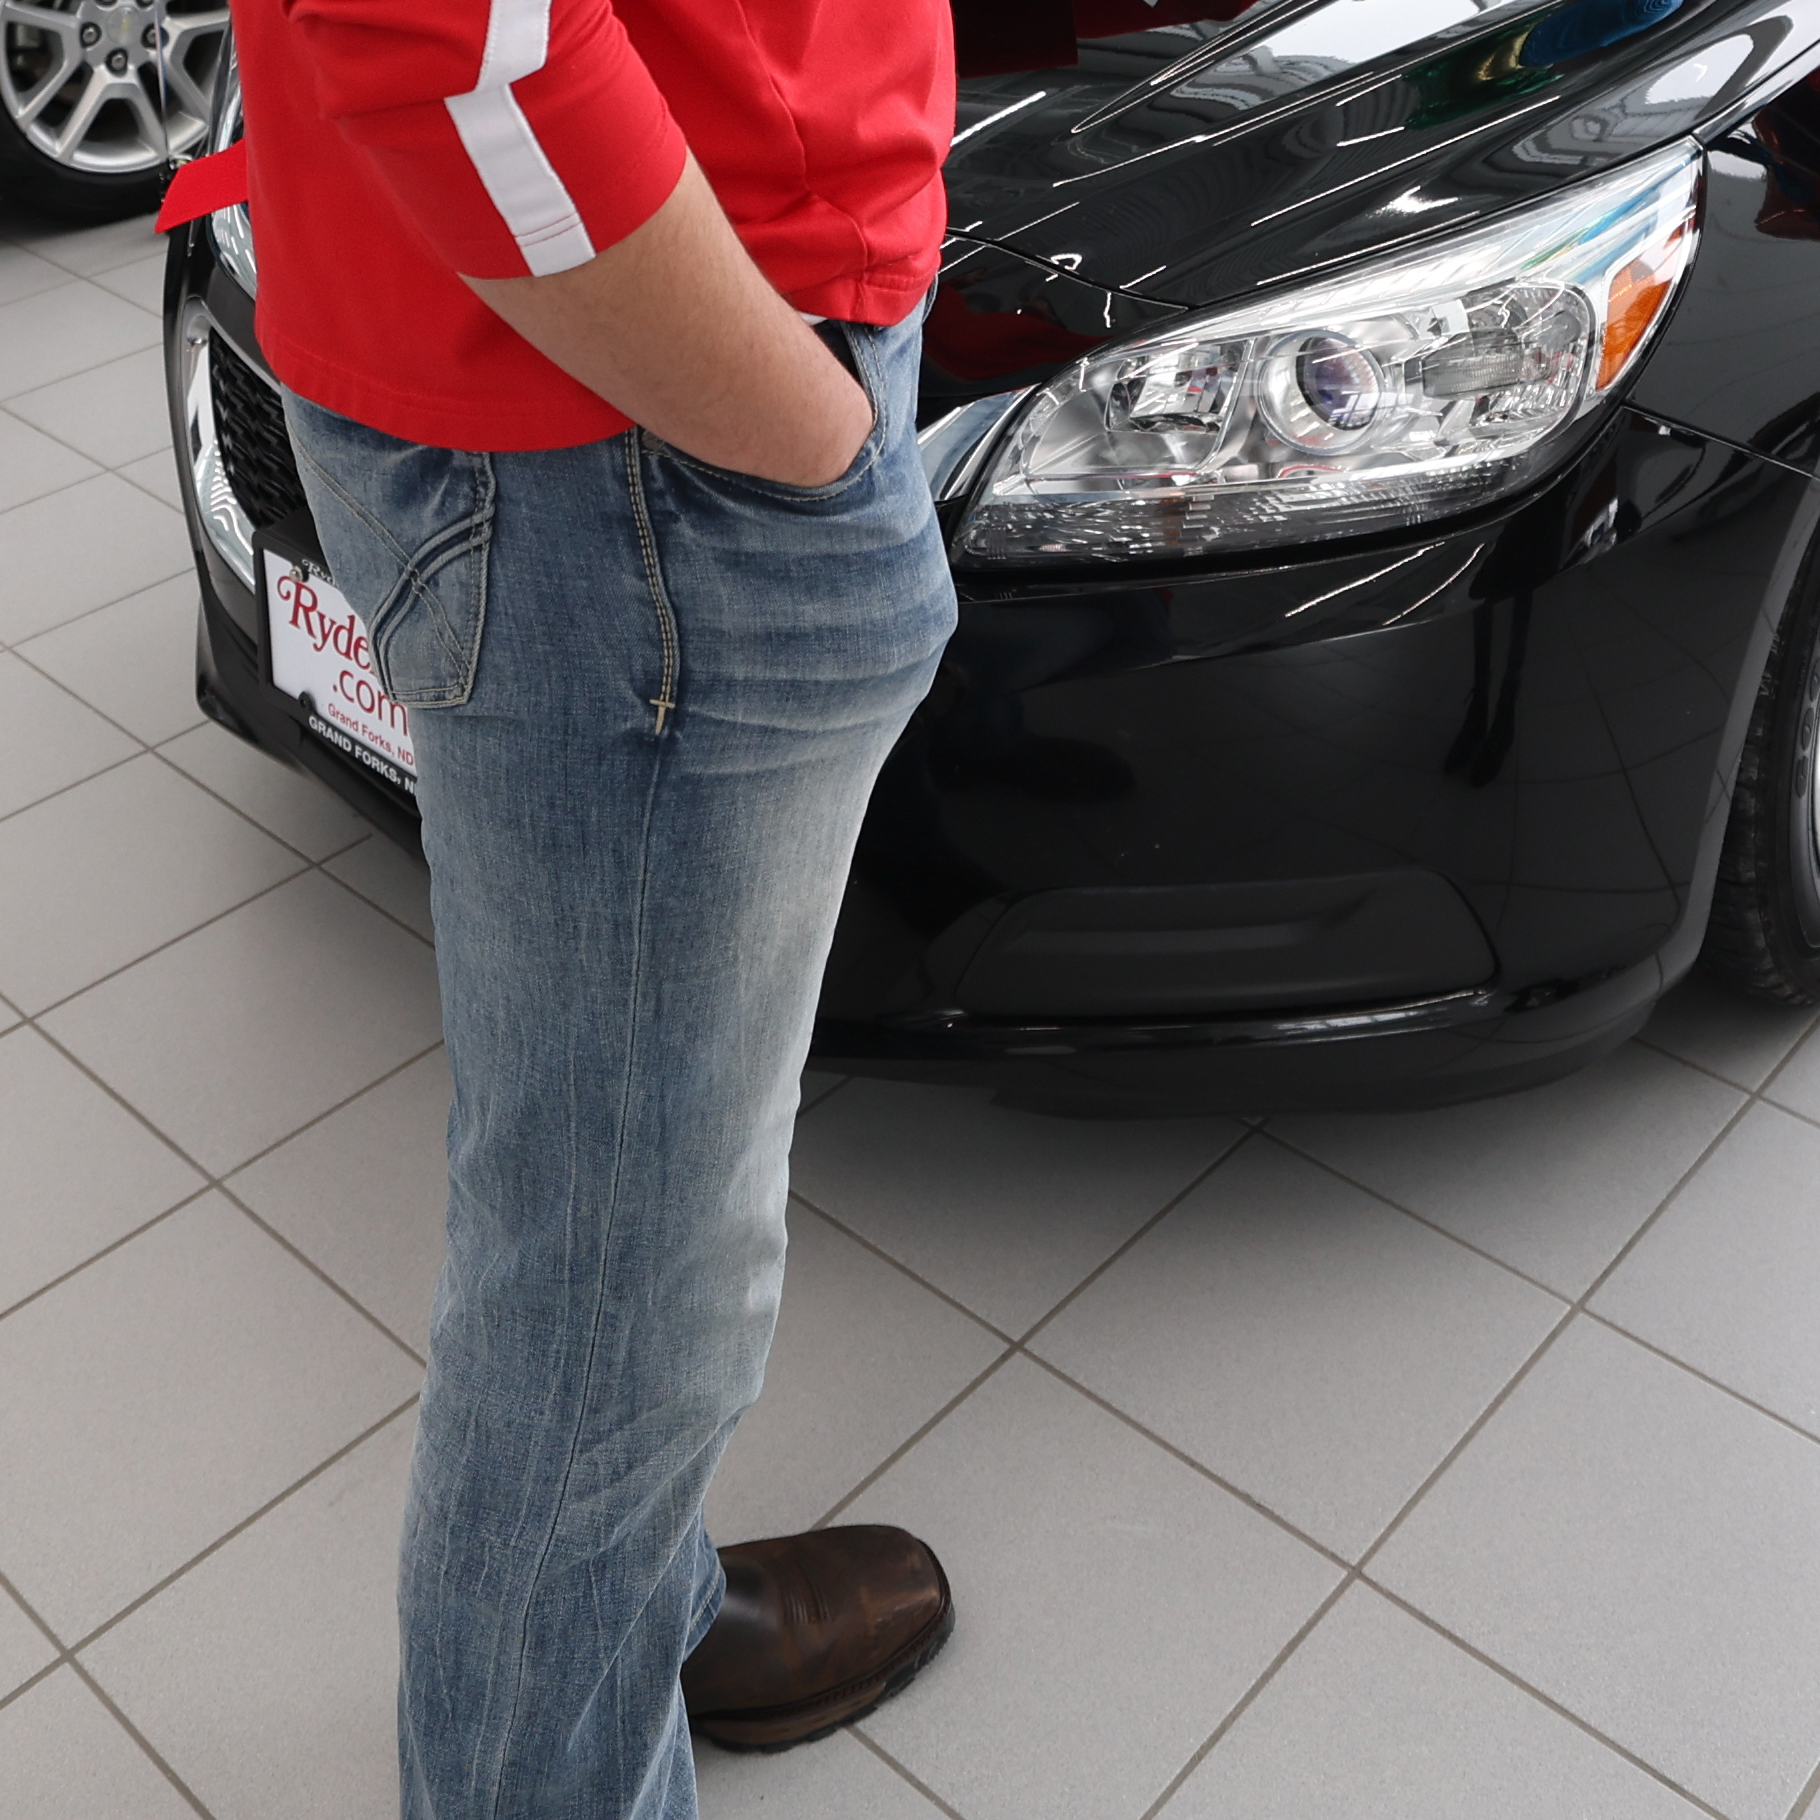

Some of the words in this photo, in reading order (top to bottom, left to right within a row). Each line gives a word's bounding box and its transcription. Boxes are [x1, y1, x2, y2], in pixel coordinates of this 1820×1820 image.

[277, 576, 375, 674] Ryde
[328, 703, 358, 732] Grand
[362, 724, 394, 757] Forks,
[397, 747, 414, 766] ND
[332, 670, 407, 736] .com
[308, 716, 352, 752] GRAND
[355, 745, 401, 785] FORKS,
[404, 778, 415, 794] N
